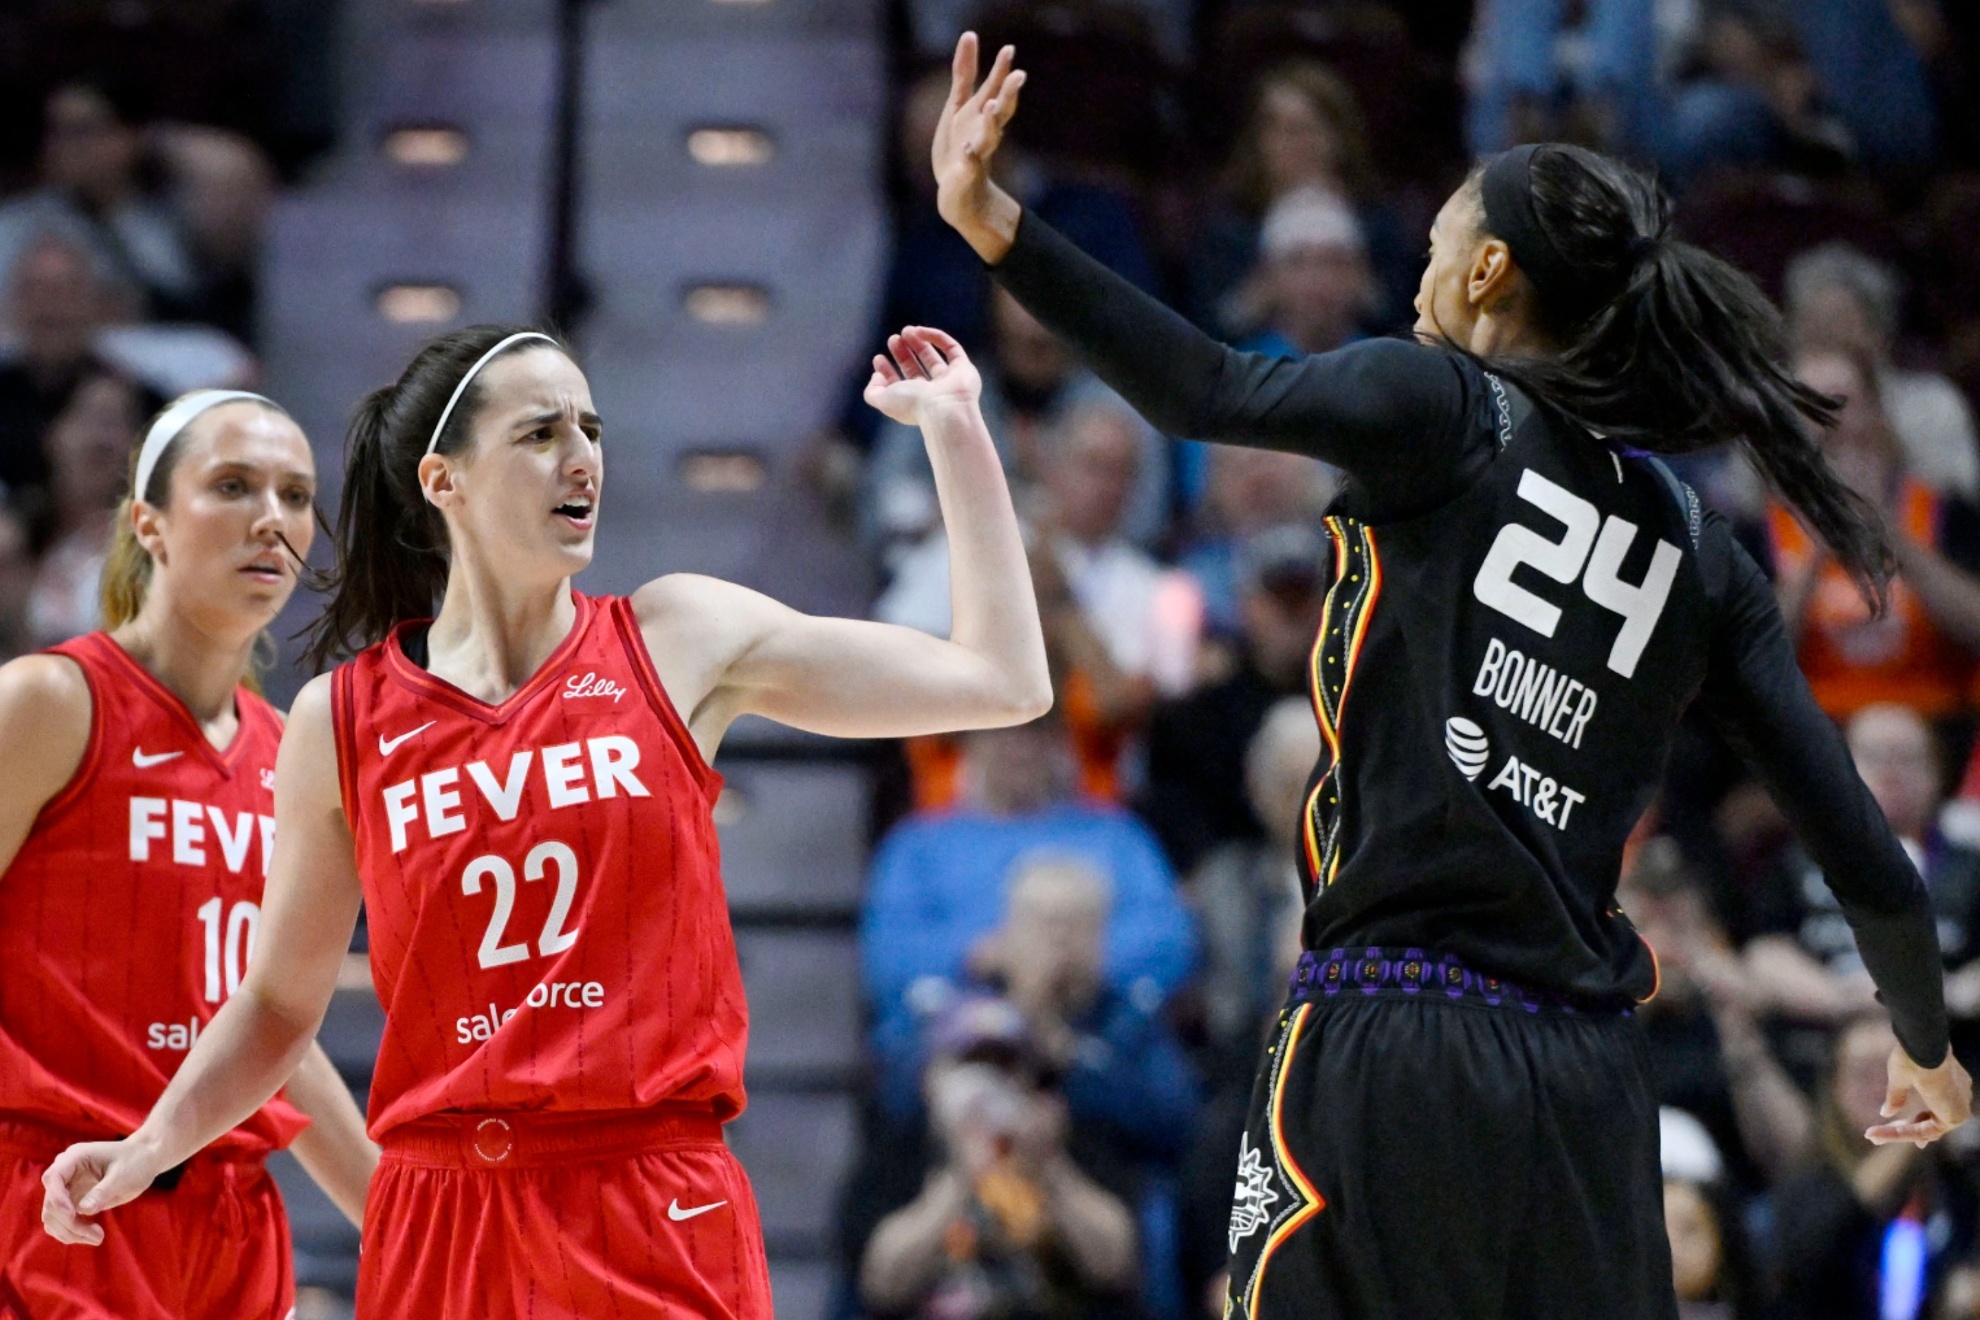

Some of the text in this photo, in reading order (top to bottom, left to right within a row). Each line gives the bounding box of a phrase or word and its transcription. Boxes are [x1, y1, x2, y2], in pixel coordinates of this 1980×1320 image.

[1473, 468, 1682, 679] 24
[563, 672, 627, 702] Lilly
[1473, 637, 1598, 750] BONNER
[383, 735, 652, 853] FEVER
[1487, 755, 1585, 830] AT&T
[197, 897, 261, 1003] 10
[461, 840, 579, 969] 22
